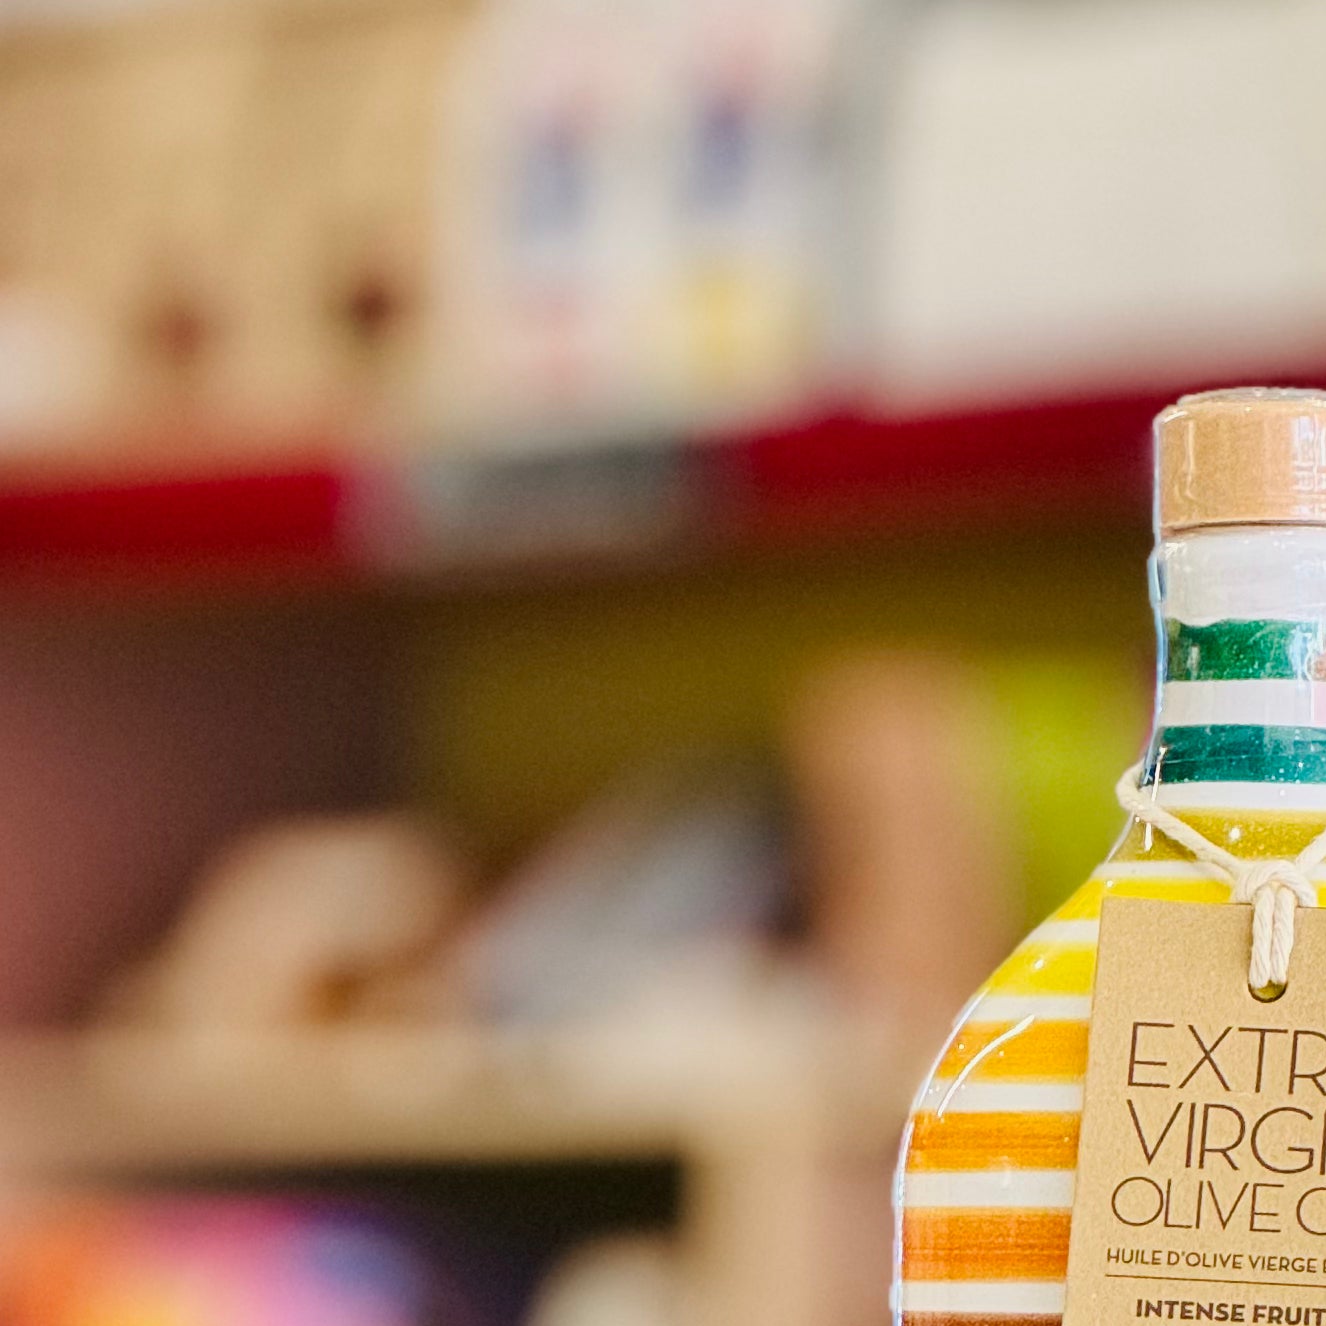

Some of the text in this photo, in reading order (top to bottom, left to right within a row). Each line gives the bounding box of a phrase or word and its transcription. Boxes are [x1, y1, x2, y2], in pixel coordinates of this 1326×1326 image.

[1111, 1175, 1286, 1233] OLIVE
[1106, 1248, 1162, 1265] HUILE
[1166, 1250, 1242, 1270] D'OLIVE
[1248, 1255, 1317, 1274] VIERGE
[1135, 1298, 1245, 1323] INTENSE
